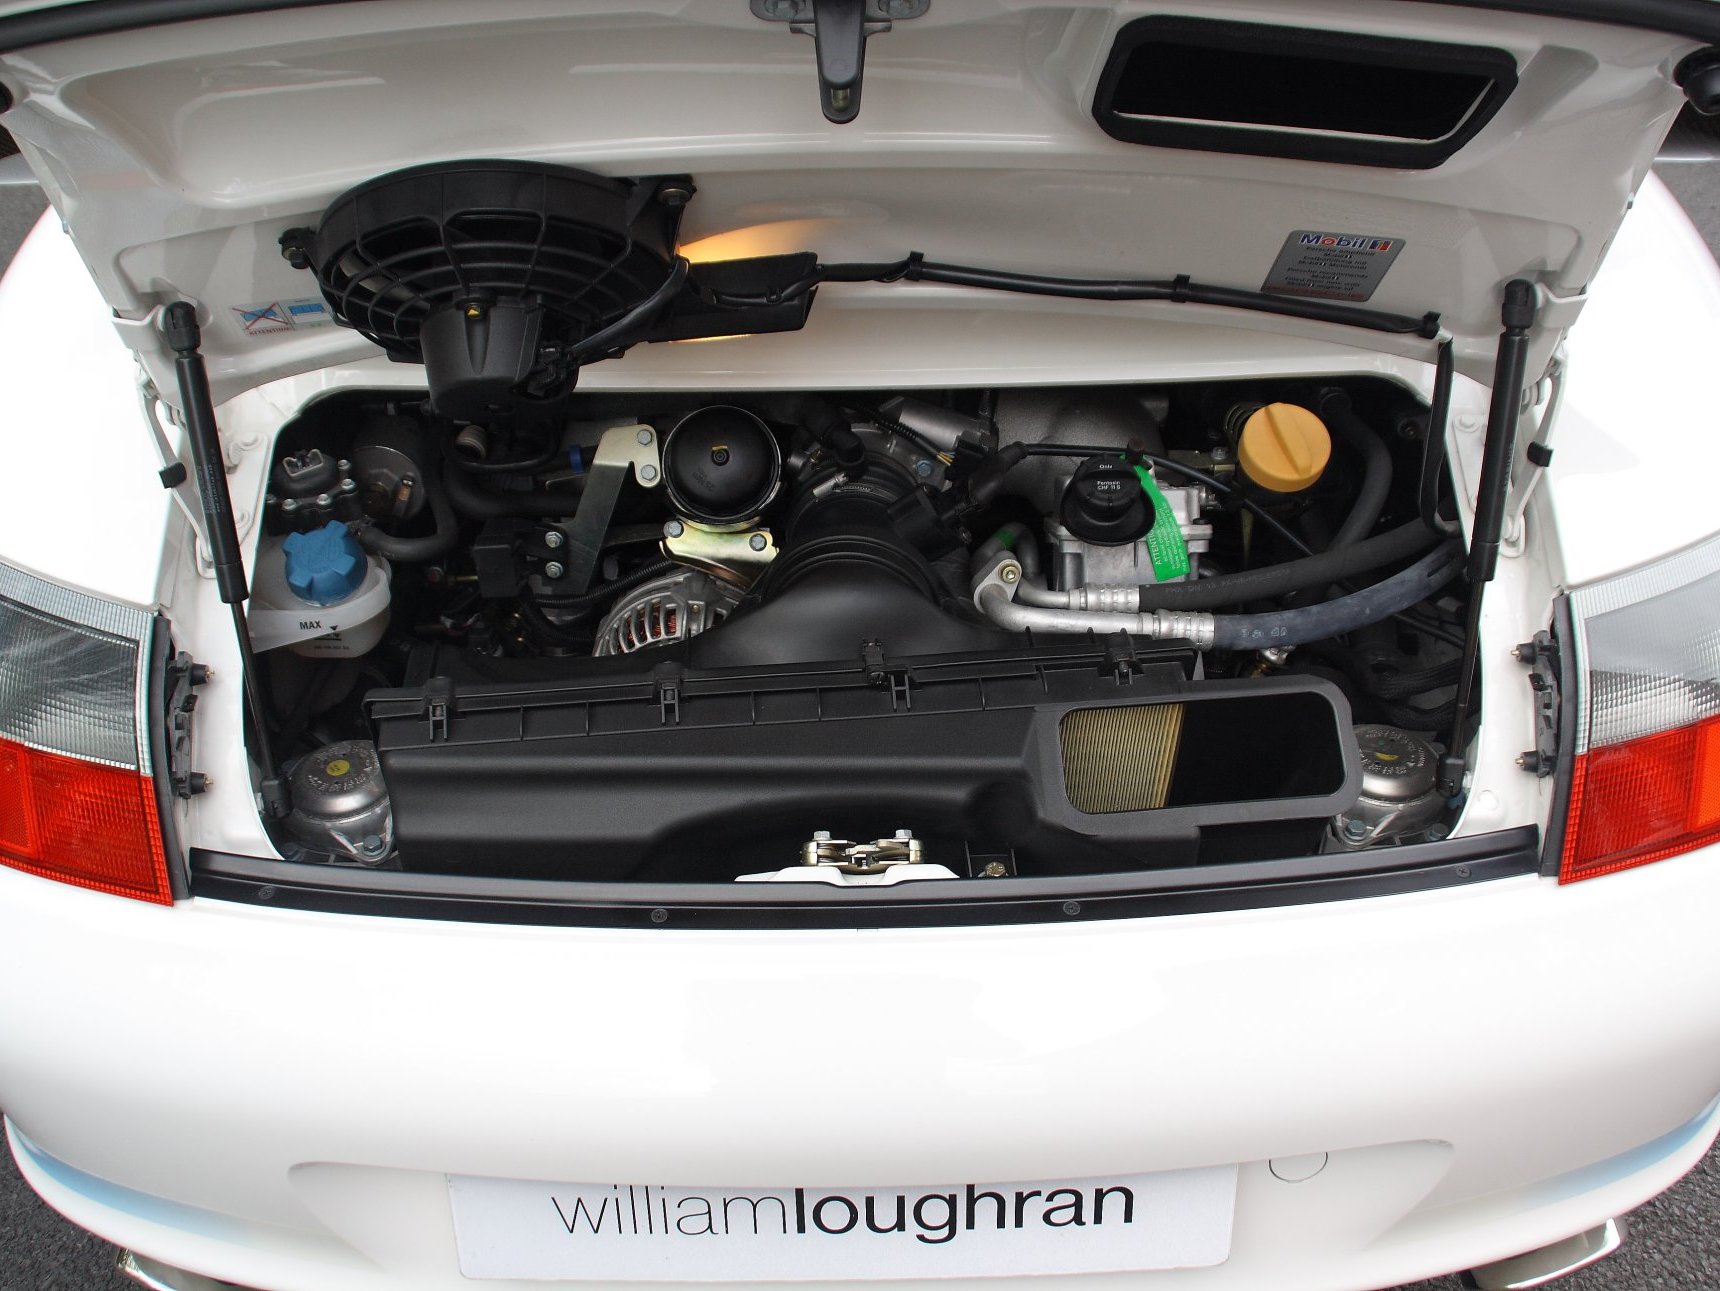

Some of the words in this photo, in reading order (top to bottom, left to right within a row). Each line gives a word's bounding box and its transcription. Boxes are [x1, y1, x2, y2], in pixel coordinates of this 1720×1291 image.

[1299, 232, 1368, 249] Mobil
[1149, 529, 1162, 565] ATTENTIO
[299, 620, 322, 630] MAX
